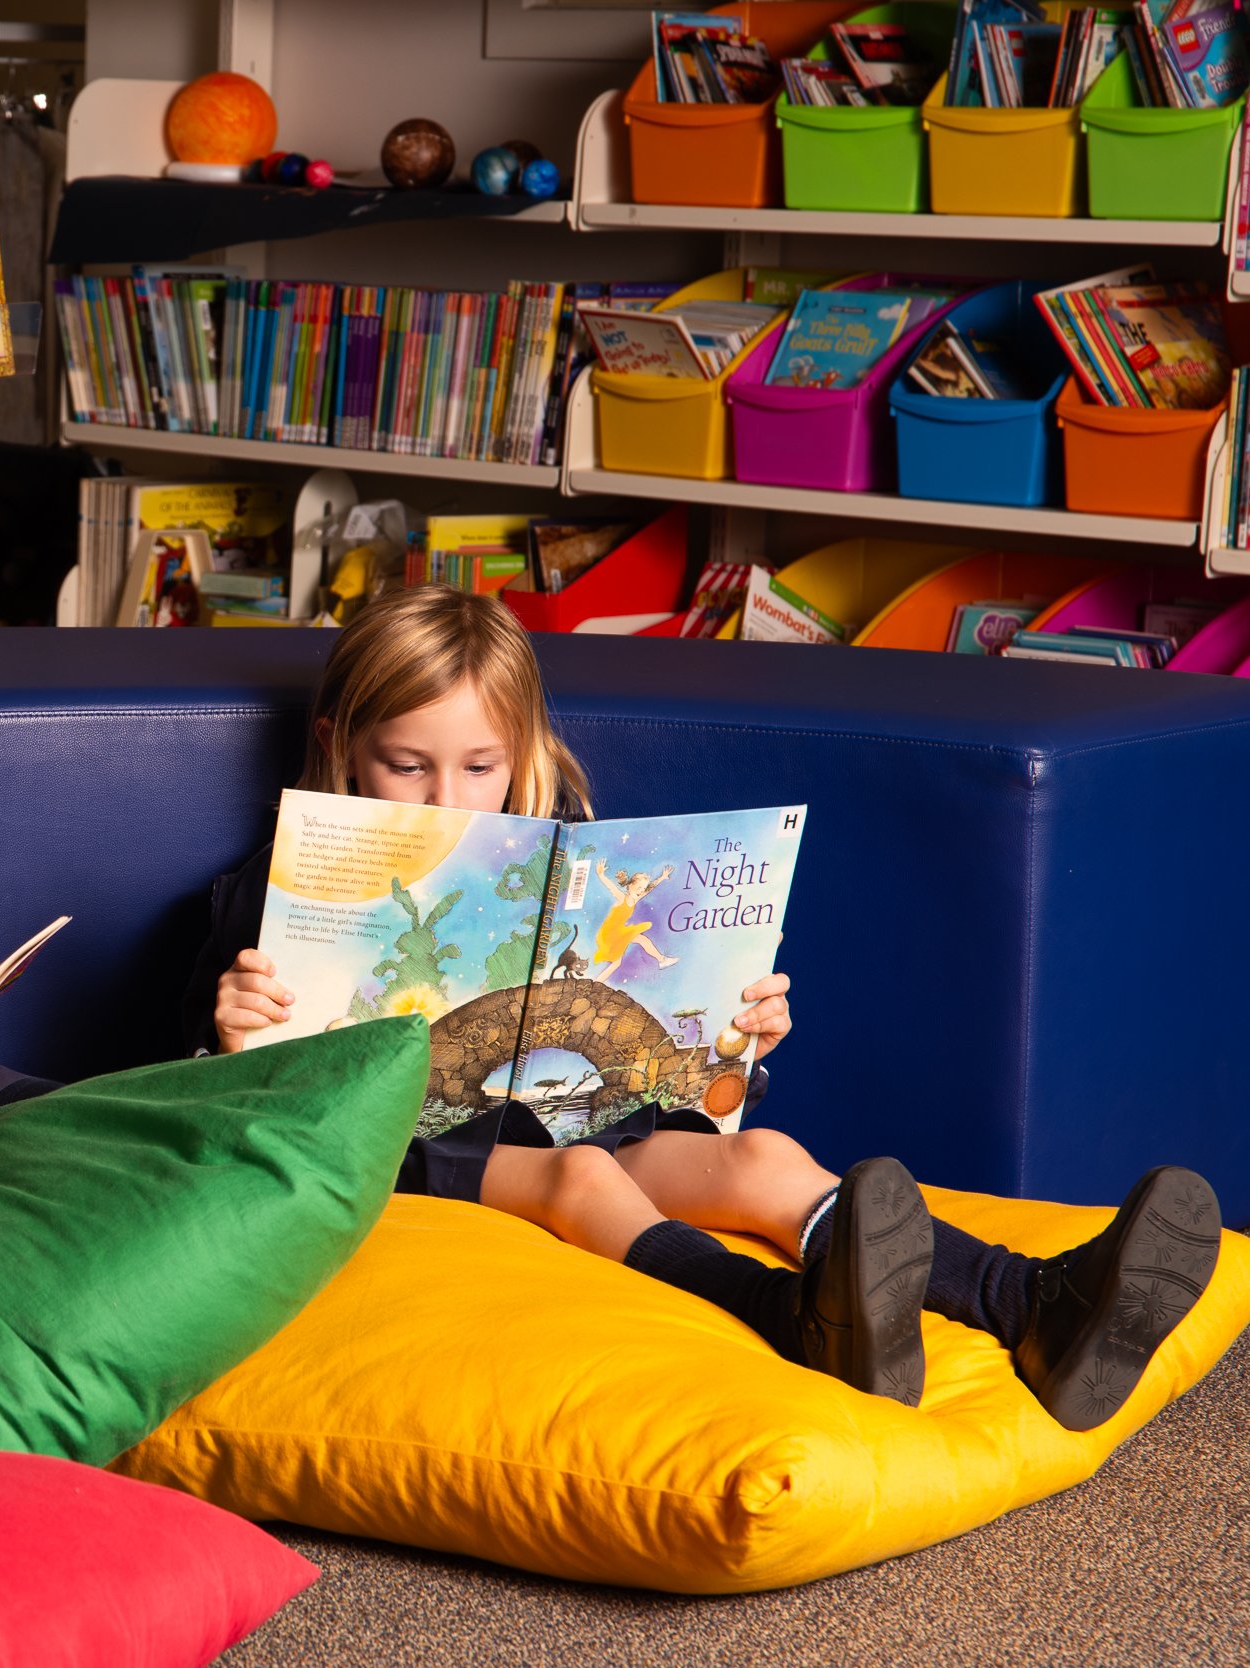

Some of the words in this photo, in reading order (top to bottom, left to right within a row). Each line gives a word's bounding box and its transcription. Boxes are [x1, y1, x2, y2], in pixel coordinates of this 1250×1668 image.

[1177, 28, 1196, 45] LEGO
[601, 331, 628, 347] NOT
[1118, 322, 1147, 345] THE
[752, 591, 815, 642] Wombat's
[302, 813, 326, 828] When
[783, 814, 798, 830] H
[302, 831, 316, 839] Sally
[381, 839, 399, 848] tiptoe
[715, 837, 742, 853] The
[312, 841, 329, 850] Night
[357, 848, 395, 858] Transformed
[396, 851, 412, 859] from
[313, 853, 334, 861] hedges
[348, 857, 368, 865] flower
[553, 849, 566, 869] The
[320, 864, 341, 872] shapes
[683, 853, 770, 897] Night
[306, 873, 327, 882] garden
[294, 882, 310, 890] magic
[543, 871, 562, 917] NIGHT
[300, 904, 334, 914] enchanting
[667, 896, 773, 933] Garden
[287, 923, 311, 931] brought
[354, 920, 392, 930] imagination,
[299, 935, 336, 944] illustrations.
[535, 916, 555, 967] GARDEN
[522, 1029, 533, 1053] Elise
[513, 1053, 529, 1081] Hurst
